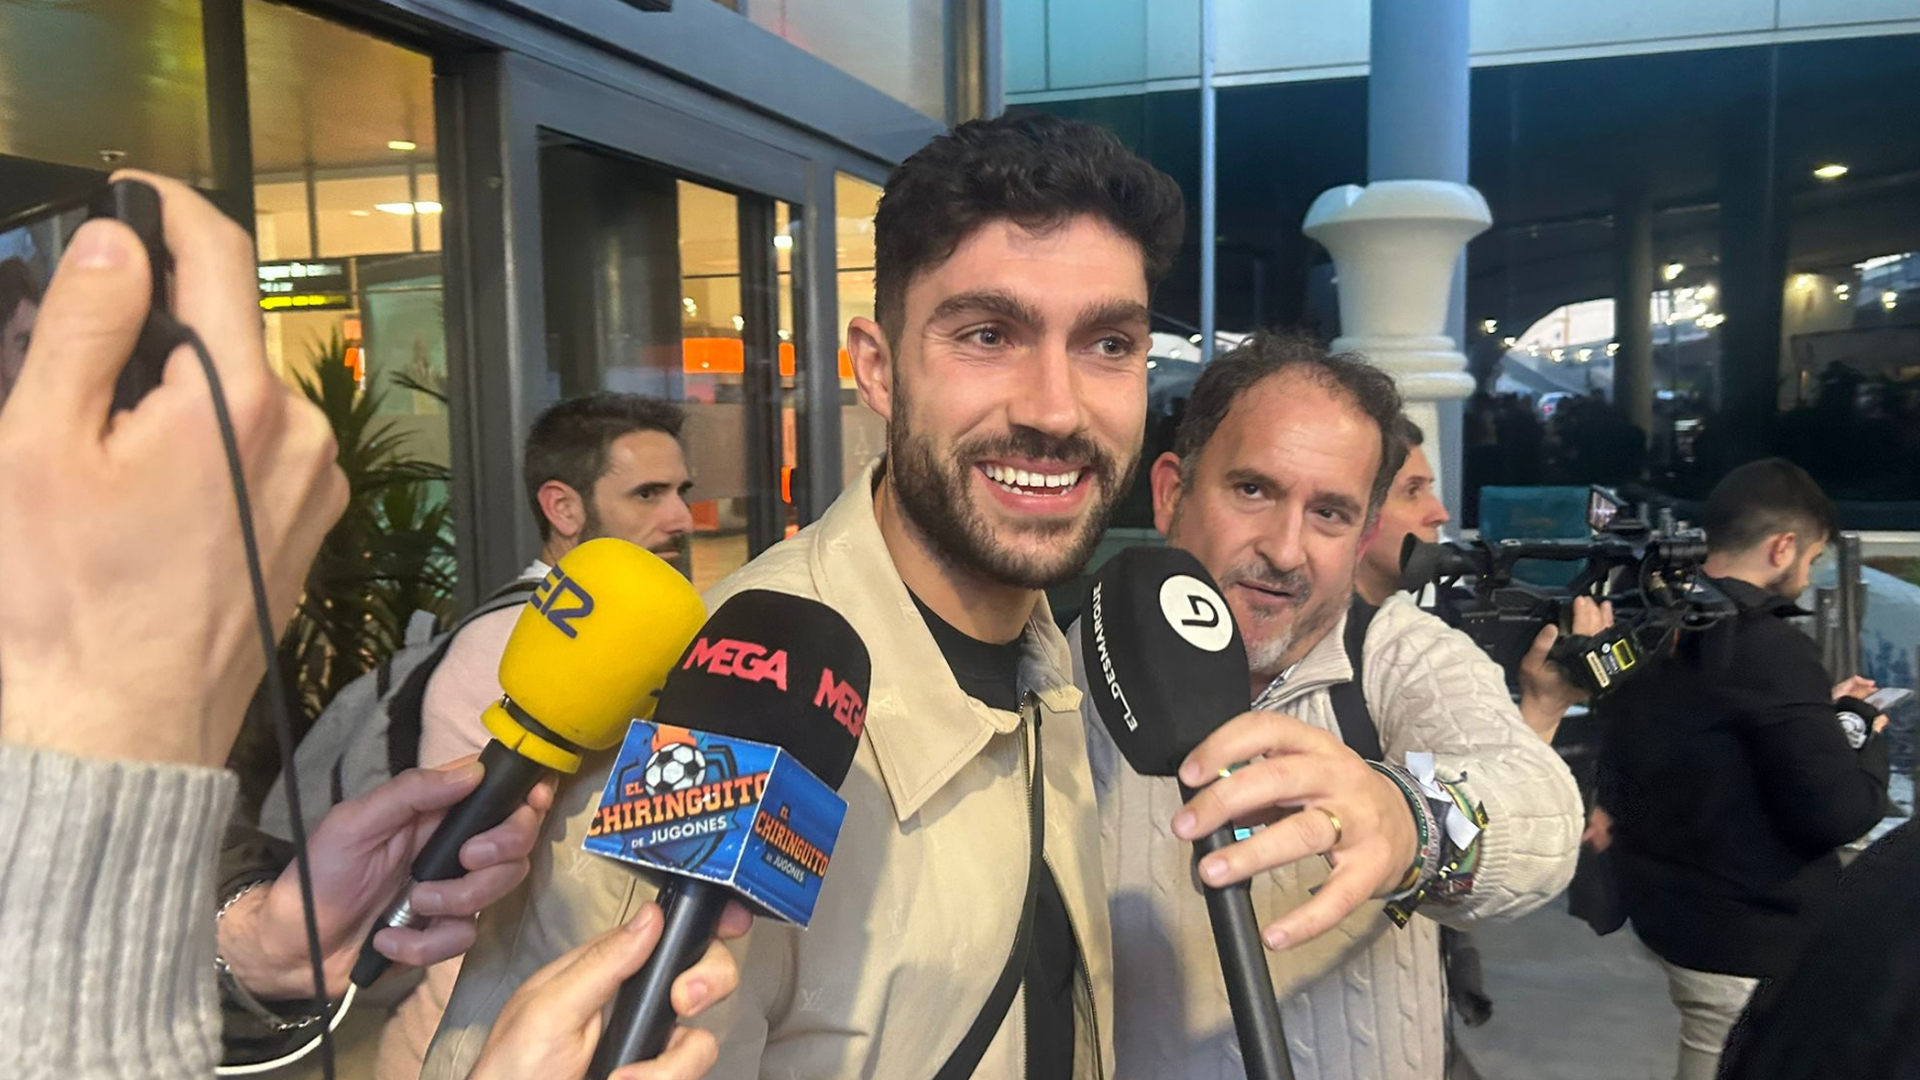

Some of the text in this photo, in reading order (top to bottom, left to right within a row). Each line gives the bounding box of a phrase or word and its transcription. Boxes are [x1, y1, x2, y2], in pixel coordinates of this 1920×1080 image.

[683, 637, 788, 692] MEGA
[625, 782, 644, 796] EL
[631, 815, 728, 849] DE JUGONES
[754, 810, 830, 877] CHIRINGUITO
[773, 854, 805, 883] JUGONES
